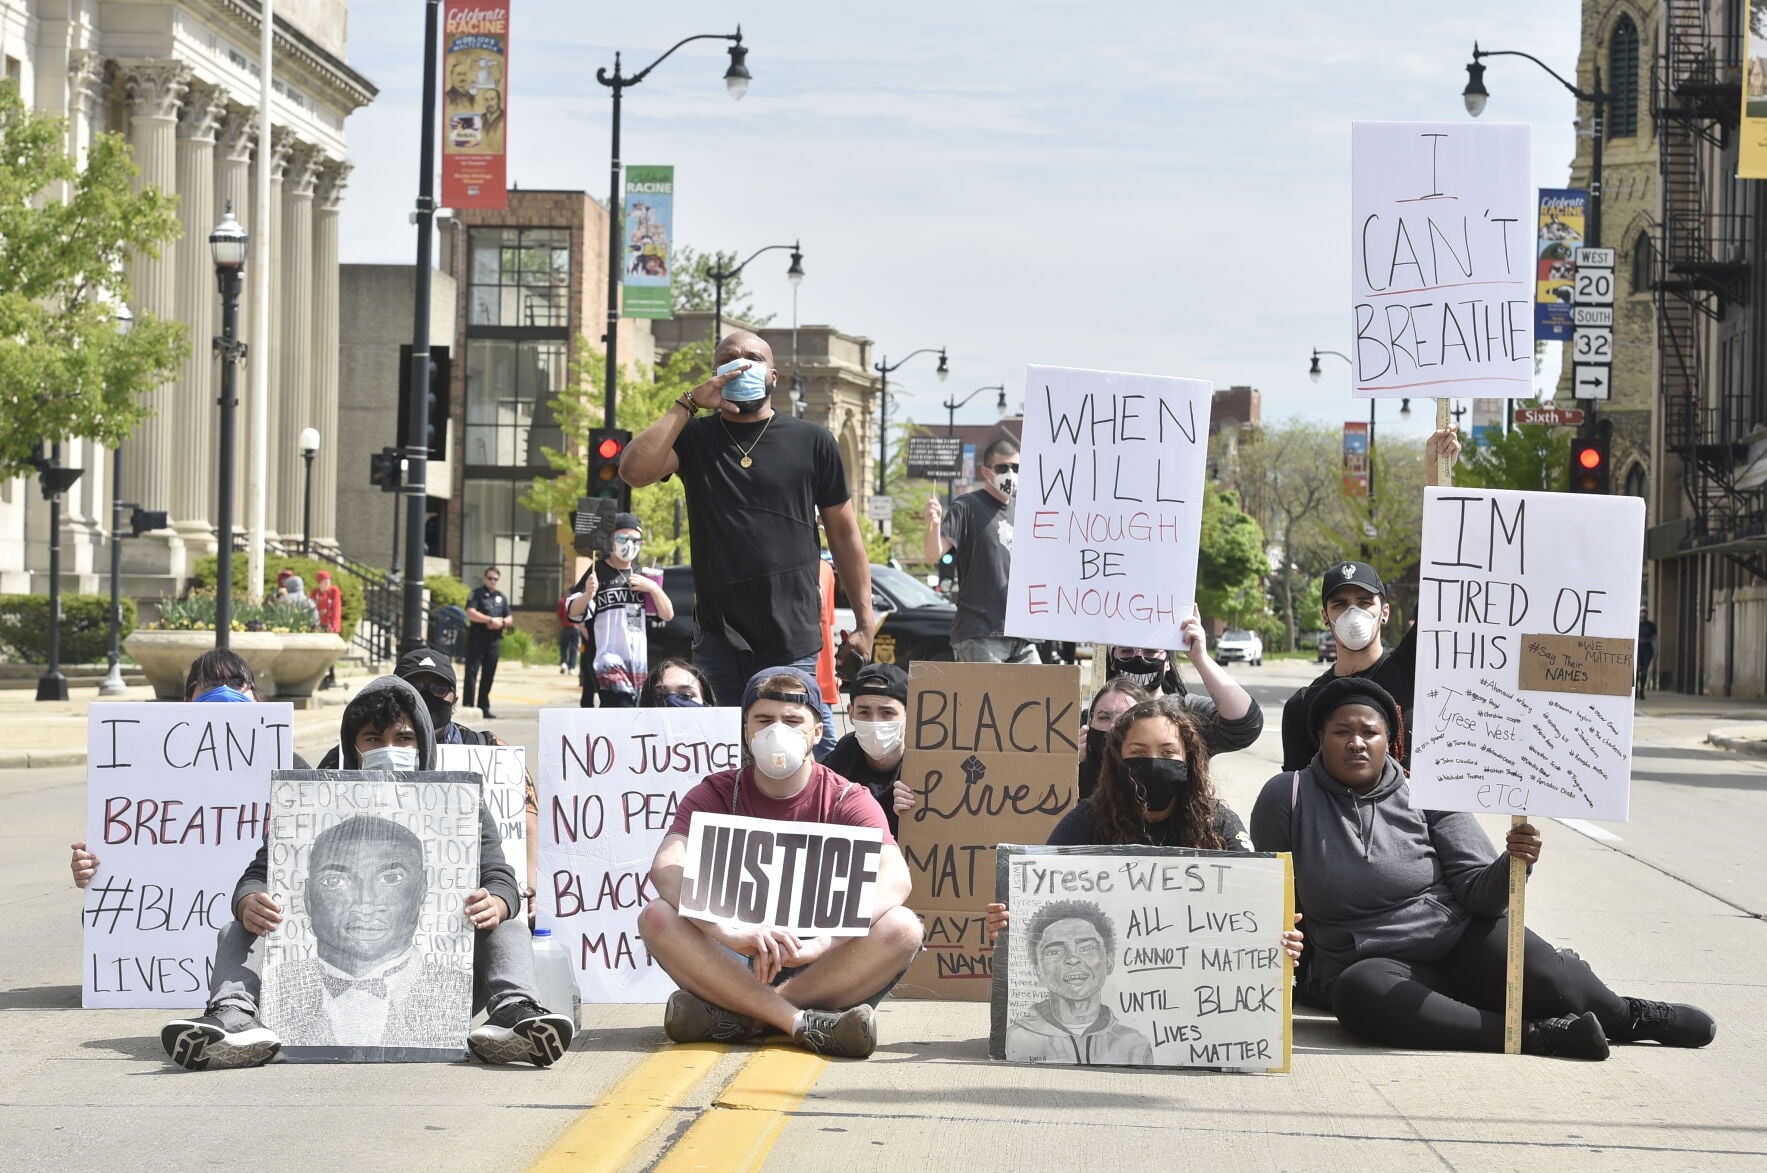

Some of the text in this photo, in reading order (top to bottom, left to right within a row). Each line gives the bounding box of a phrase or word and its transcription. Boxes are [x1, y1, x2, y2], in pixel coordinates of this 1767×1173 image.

[447, 20, 506, 33] RACINE
[448, 8, 506, 22] Celebrate
[1420, 133, 1448, 199] I
[627, 182, 673, 193] RACINE
[1363, 209, 1518, 291] CAN'T
[1581, 251, 1609, 263] WEST
[1579, 275, 1610, 296] 20
[1577, 310, 1611, 323] SOUTH
[1354, 301, 1531, 382] BREATHE
[1578, 334, 1609, 356] 32
[1045, 385, 1196, 446] WHEN
[1525, 410, 1559, 423] Sixth
[1039, 448, 1185, 506] WILL
[1033, 511, 1178, 543] ENOUGH
[1431, 497, 1525, 575] IM
[1080, 549, 1127, 580] BE
[598, 591, 627, 606] NEW
[1028, 584, 1175, 624] ENOUGH
[1422, 577, 1607, 637] TIRED OF
[1421, 630, 1507, 669] THIS
[1528, 642, 1585, 668] #Say Their
[1585, 651, 1633, 668] MATTER
[915, 690, 1078, 753] BLACK
[1486, 721, 1516, 741] West
[97, 716, 290, 771] I CAN'T
[562, 734, 739, 781] NO JUSTICE
[488, 788, 525, 819] ND
[914, 770, 1073, 822] Lives
[552, 791, 678, 844] NO PEA
[681, 825, 882, 930] JUSTICE
[905, 843, 998, 899] MAT
[1012, 861, 1231, 894] Tyrese WEST
[86, 876, 226, 934] #BLAC
[553, 870, 653, 917] BLACK
[1126, 905, 1259, 939] ALL LIVES
[937, 953, 992, 976] NAM
[1123, 946, 1281, 972] CANNOT MATTER
[1119, 984, 1276, 1017] UNTIL BLACK
[1153, 1021, 1202, 1047] LIVES
[1190, 1039, 1272, 1064] MATTER
